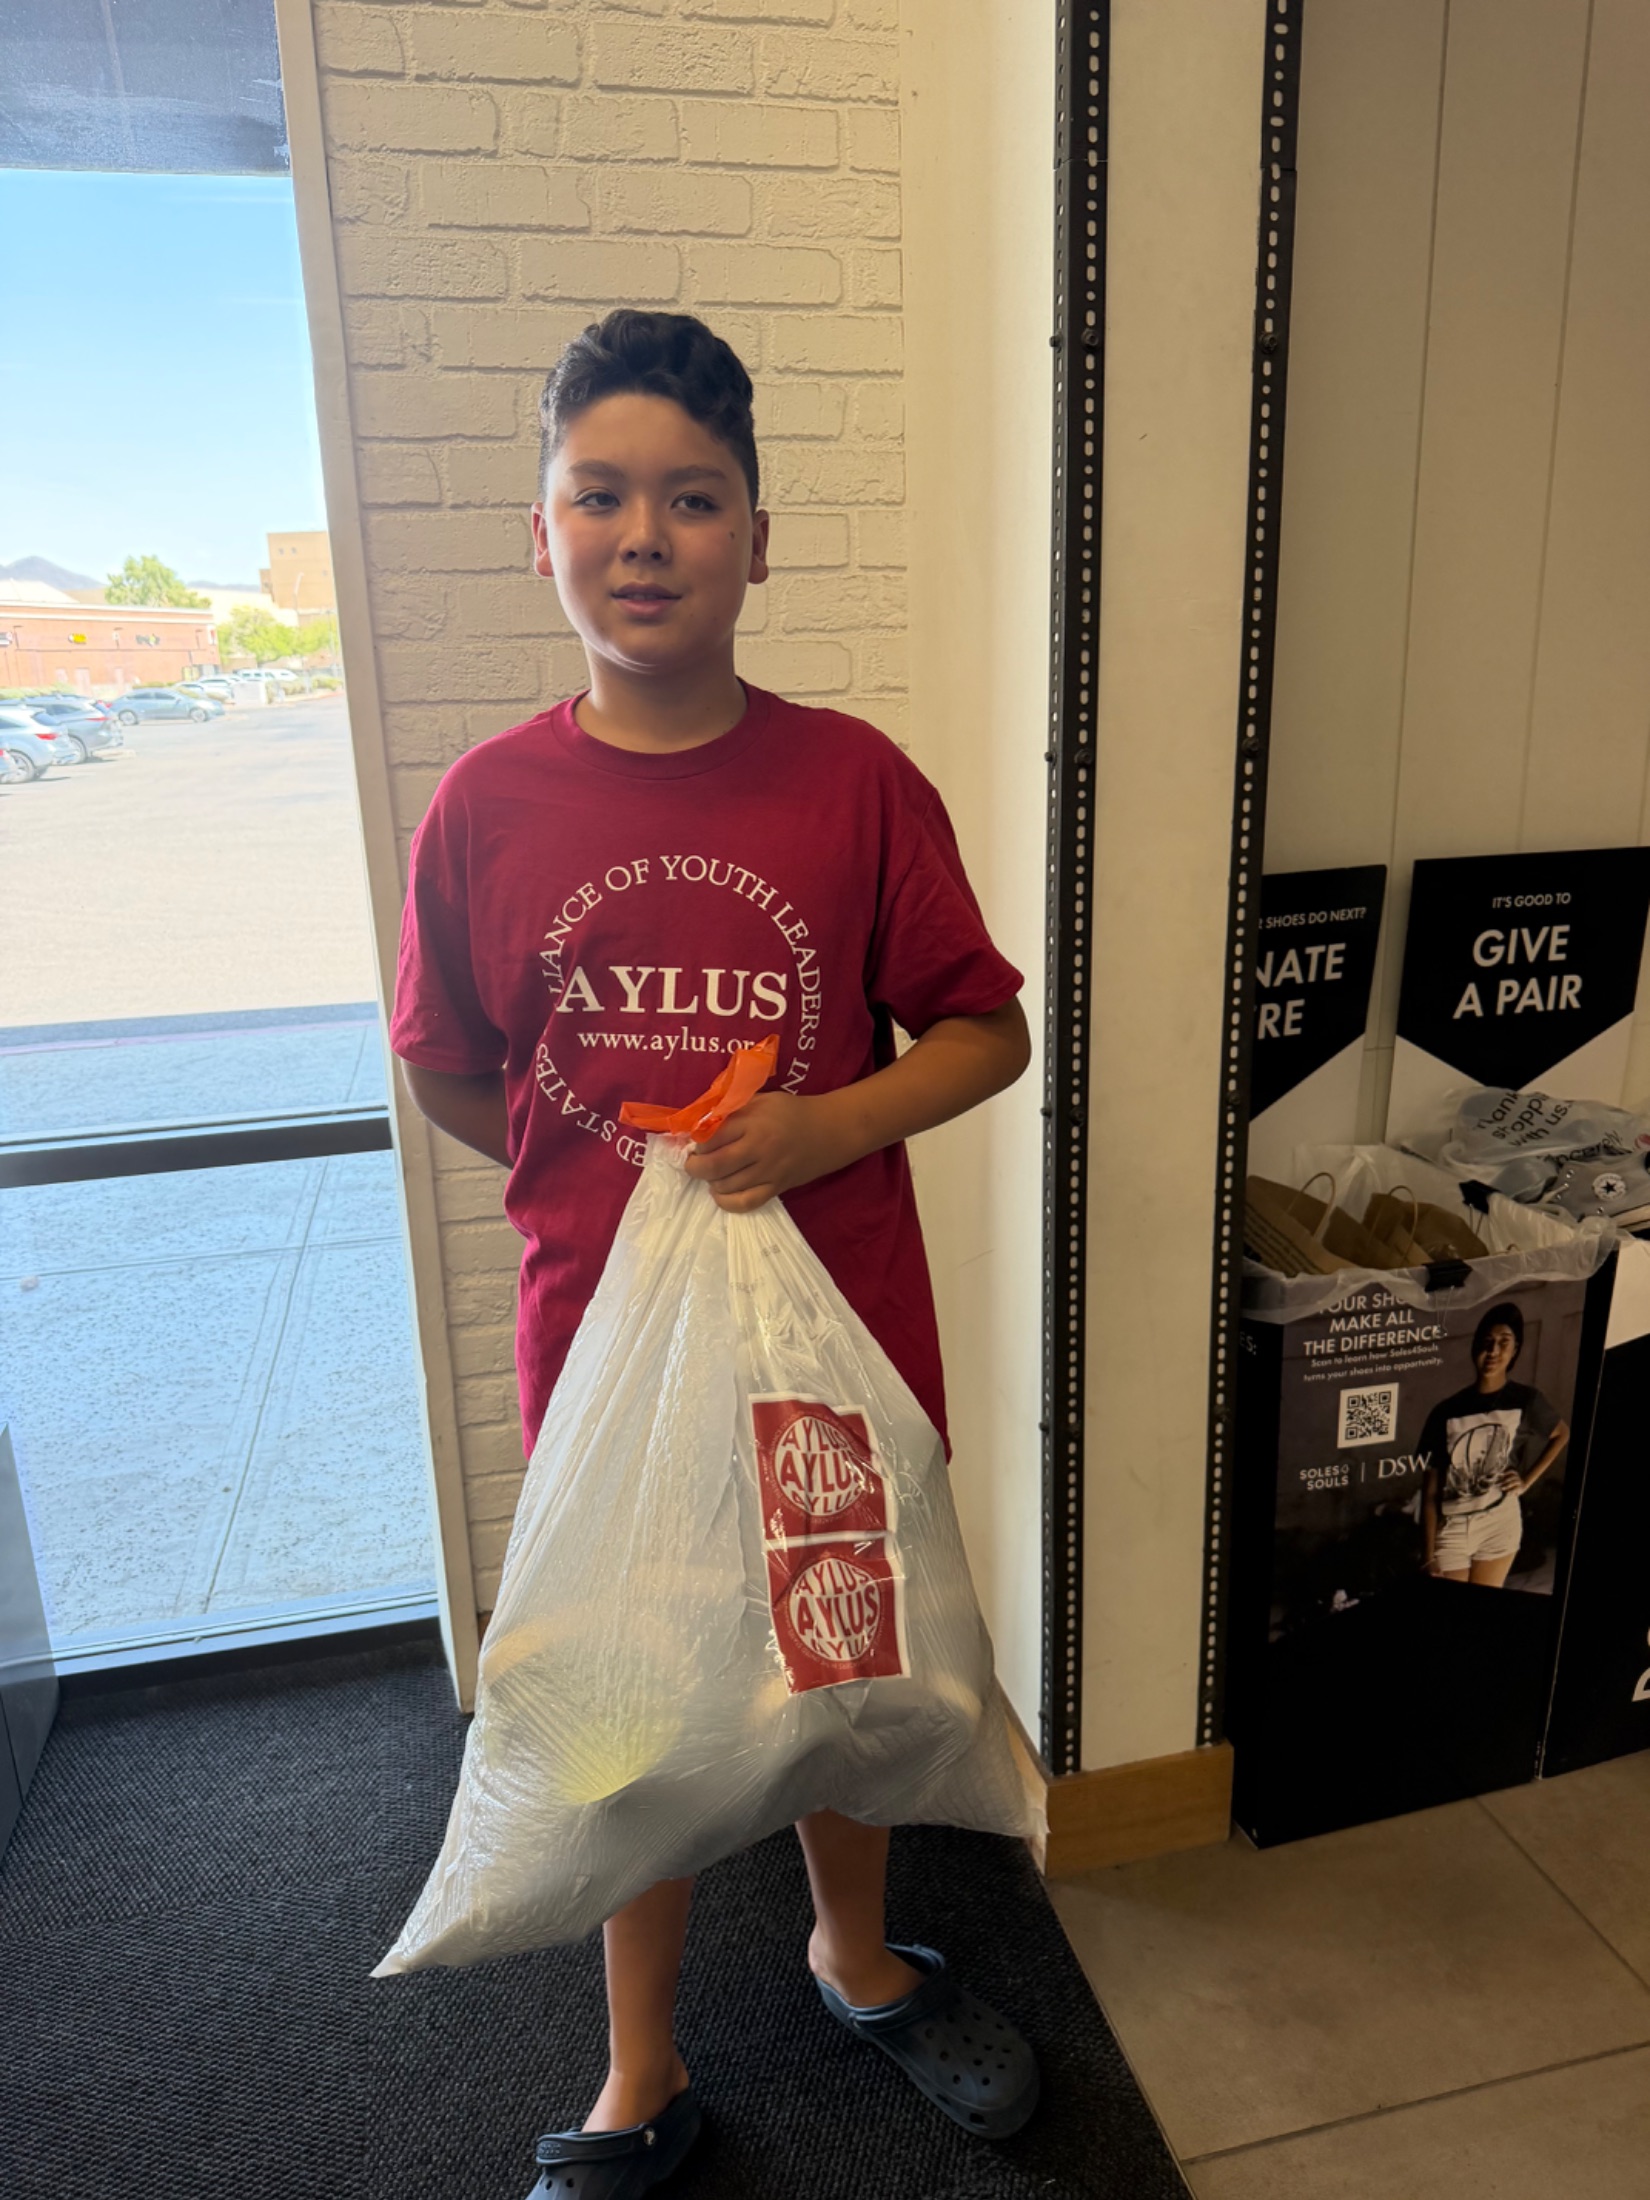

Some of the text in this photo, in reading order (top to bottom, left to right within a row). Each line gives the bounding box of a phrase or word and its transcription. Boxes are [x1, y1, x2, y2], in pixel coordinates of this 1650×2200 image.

[1492, 891, 1572, 909] IT'S GOOD TO
[1265, 912, 1306, 929] SHOES
[1307, 910, 1328, 925] DO
[1329, 906, 1367, 922] NEXT?
[1472, 924, 1572, 968] GIVE
[539, 854, 822, 1096] LIANCE OF YOUTH LEADERS IN
[556, 964, 788, 1021] AYLUS
[1452, 973, 1584, 1020] A PAIR
[1254, 998, 1306, 1040] RE
[535, 1042, 619, 1142] STATES
[1319, 1294, 1367, 1315] OUR
[1329, 1309, 1415, 1334] MAKE ALL
[1303, 1326, 1448, 1356] THE DIFFERENCE.
[1303, 1373, 1326, 1382] turns
[1327, 1370, 1348, 1381] your
[1349, 1366, 1374, 1376] shoes
[1375, 1363, 1392, 1373] into
[1311, 1358, 1332, 1368] Scan
[1333, 1357, 1343, 1365] to
[1344, 1353, 1368, 1364] learn
[1369, 1351, 1388, 1361] how
[782, 1418, 848, 1452] AYLUS
[1377, 1451, 1433, 1480] DSW
[1306, 1475, 1349, 1491] SOULS
[795, 1560, 870, 1596] AYLUS
[797, 1584, 879, 1639] AYLUS
